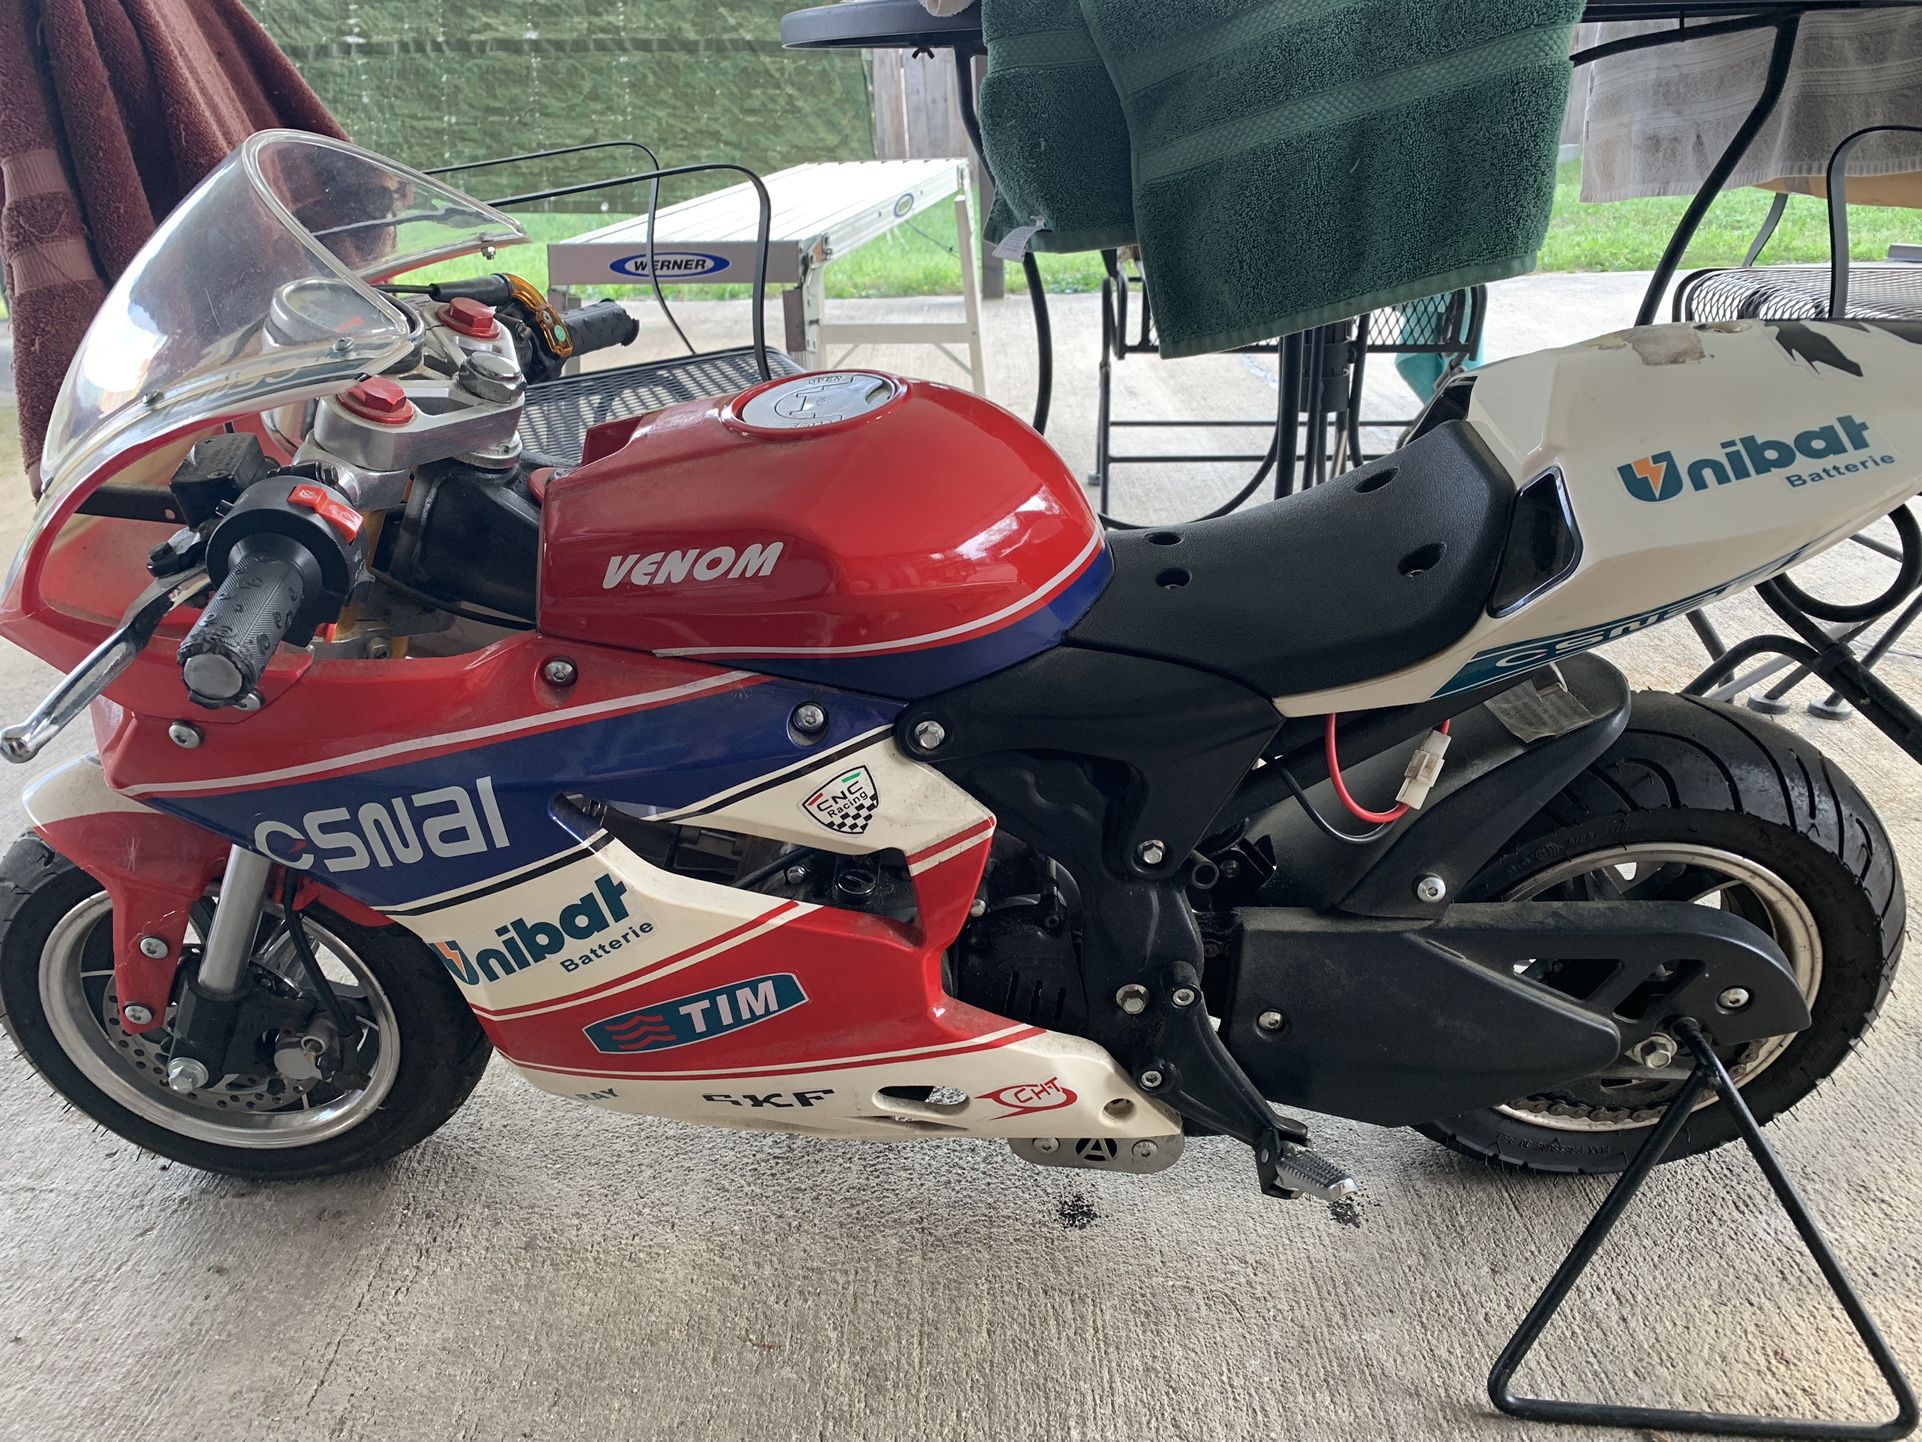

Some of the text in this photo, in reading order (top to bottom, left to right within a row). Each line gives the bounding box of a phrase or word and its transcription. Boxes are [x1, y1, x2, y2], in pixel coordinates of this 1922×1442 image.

[634, 258, 707, 271] WERNER
[1617, 414, 1870, 503] Unibat
[1785, 452, 1896, 488] Batterie
[603, 541, 784, 590] VENOM
[816, 780, 864, 812] CNC
[827, 791, 868, 818] Racing
[428, 873, 629, 986] Unibat
[560, 922, 654, 973] Batterie
[679, 979, 779, 1034] TIM
[702, 1088, 835, 1108] SKF
[1013, 1076, 1062, 1104] CHT
